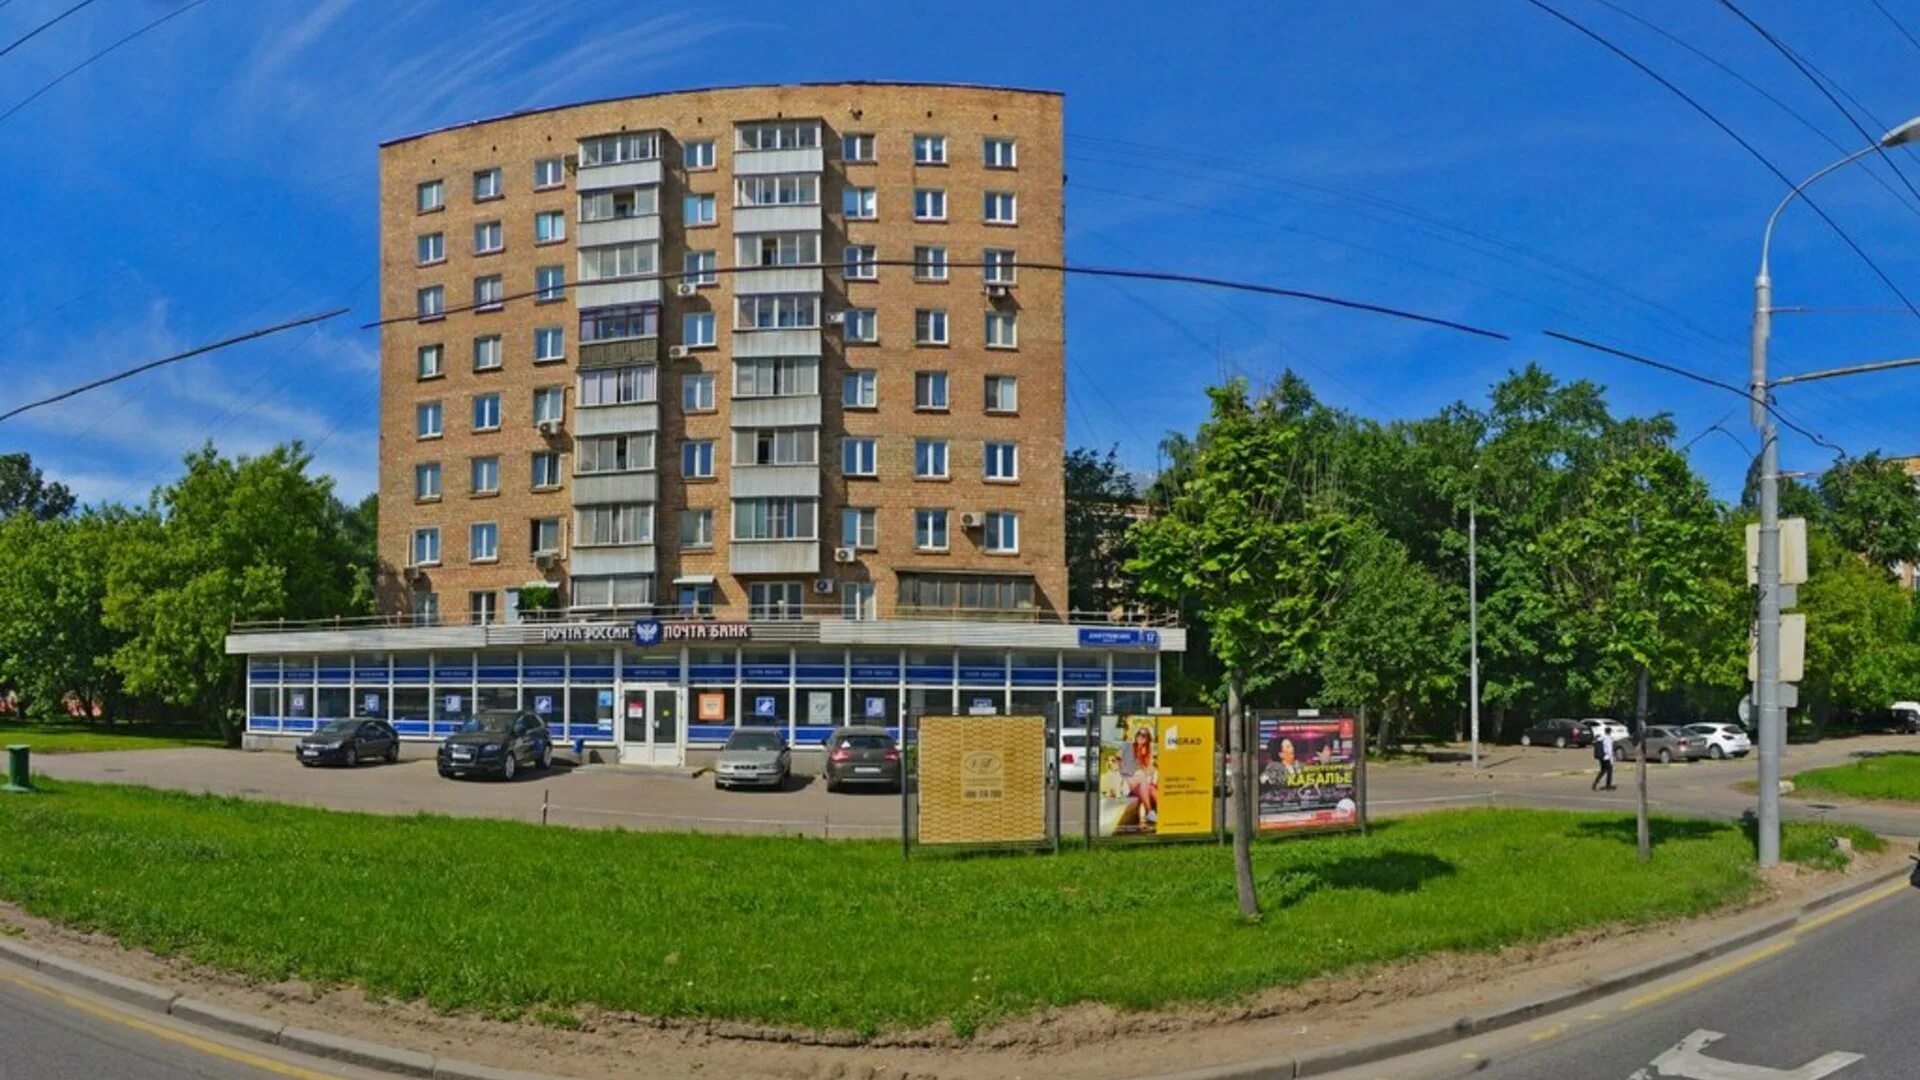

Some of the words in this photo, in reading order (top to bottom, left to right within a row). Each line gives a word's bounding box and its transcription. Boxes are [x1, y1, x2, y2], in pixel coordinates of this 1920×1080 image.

[543, 627, 582, 640] ПОЧТА
[663, 624, 706, 639] ПОЧТА
[709, 623, 749, 638] БАНК
[1287, 772, 1353, 787] КАБАЛЬЕ
